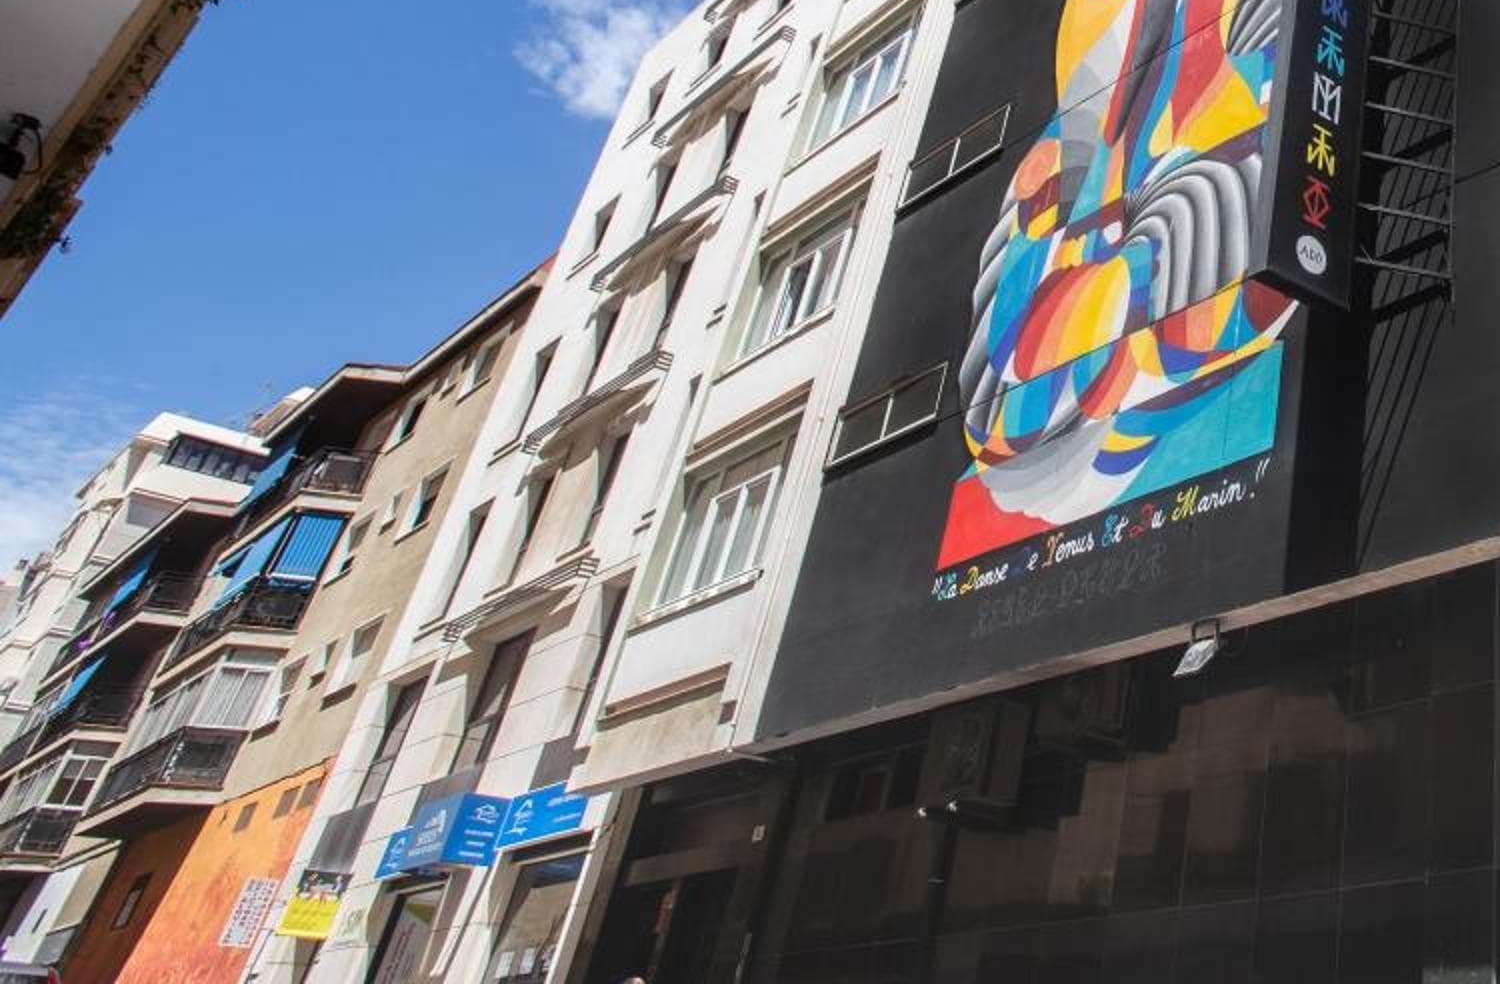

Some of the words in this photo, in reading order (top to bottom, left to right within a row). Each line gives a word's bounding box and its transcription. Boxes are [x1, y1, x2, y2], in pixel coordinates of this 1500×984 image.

[959, 564, 1010, 596] Danse
[1041, 530, 1095, 569] Venus
[1100, 513, 1130, 548] Et
[1127, 502, 1166, 538] Du
